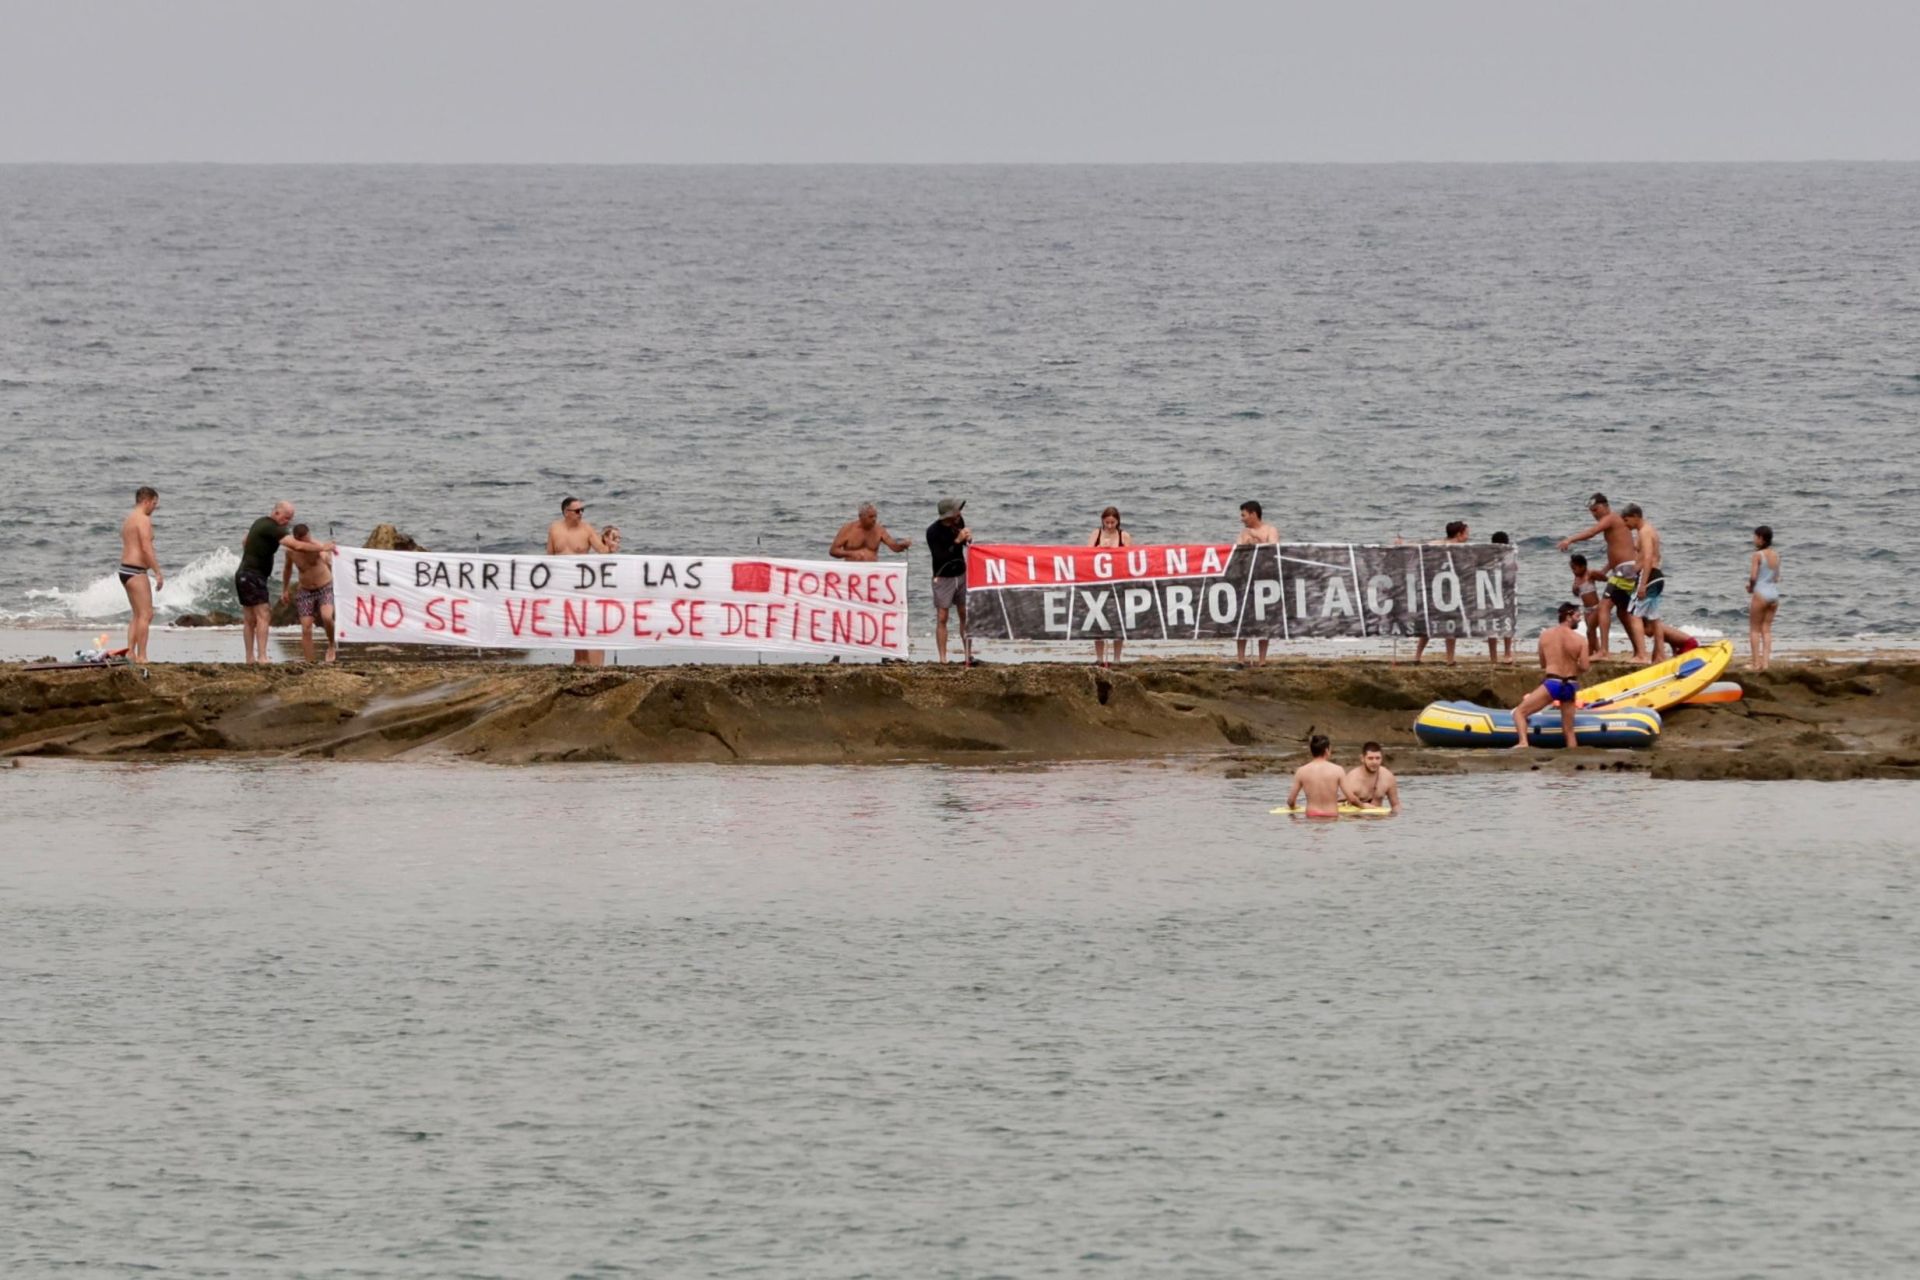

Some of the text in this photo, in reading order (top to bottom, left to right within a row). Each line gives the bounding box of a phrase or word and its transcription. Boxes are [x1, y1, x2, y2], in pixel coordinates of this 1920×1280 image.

[354, 559, 898, 605] EL BARRIO DE LAS TORRES
[985, 547, 1222, 584] NINGUNA
[1043, 562, 1505, 632] EXPROPIACIÓN
[355, 595, 404, 628] NO
[425, 598, 469, 634] SE
[720, 602, 898, 648] DEFIENDE
[1379, 621, 1416, 635] LAS
